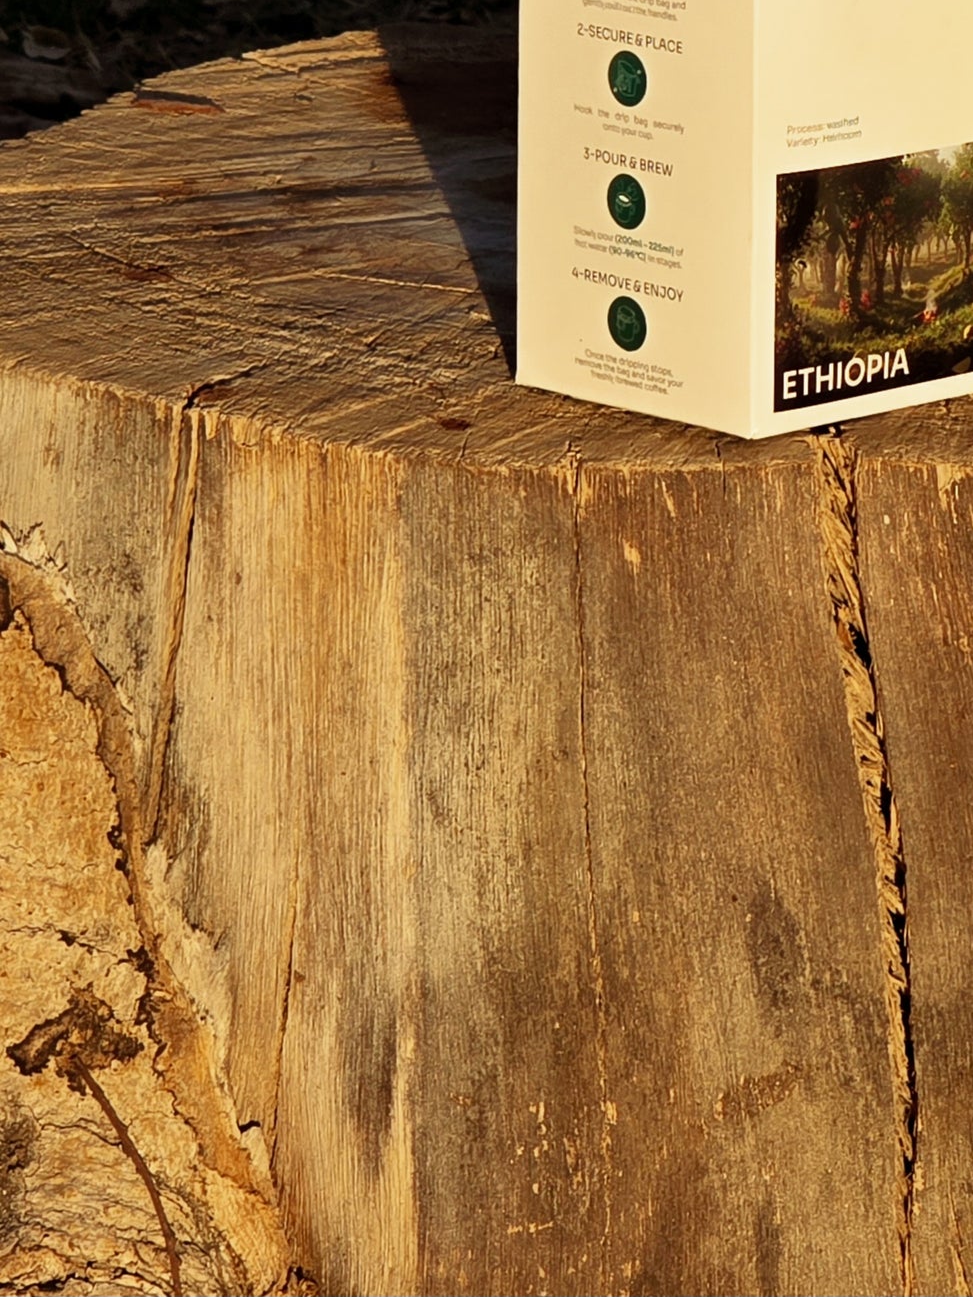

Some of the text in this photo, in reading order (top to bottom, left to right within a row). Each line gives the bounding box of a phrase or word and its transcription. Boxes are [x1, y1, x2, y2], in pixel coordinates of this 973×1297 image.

[577, 22, 683, 54] 2-SECURE & PLACE
[574, 104, 684, 134] Hook the drip bag securely
[602, 123, 653, 140] onto your cup.
[826, 116, 859, 129] washed
[583, 147, 673, 177] 3-POUR & BREW
[574, 225, 596, 240] Slowly
[597, 232, 613, 242] pour
[676, 248, 684, 256] of
[571, 266, 684, 302] 4-REMOVE & ENJOY
[575, 357, 684, 388] remove the bag and savor your
[585, 348, 604, 361] Once
[605, 354, 617, 363] the
[619, 358, 649, 372] dripping
[783, 348, 910, 400] ETHIOPIA
[590, 370, 668, 395] freshly brewed coffee.
